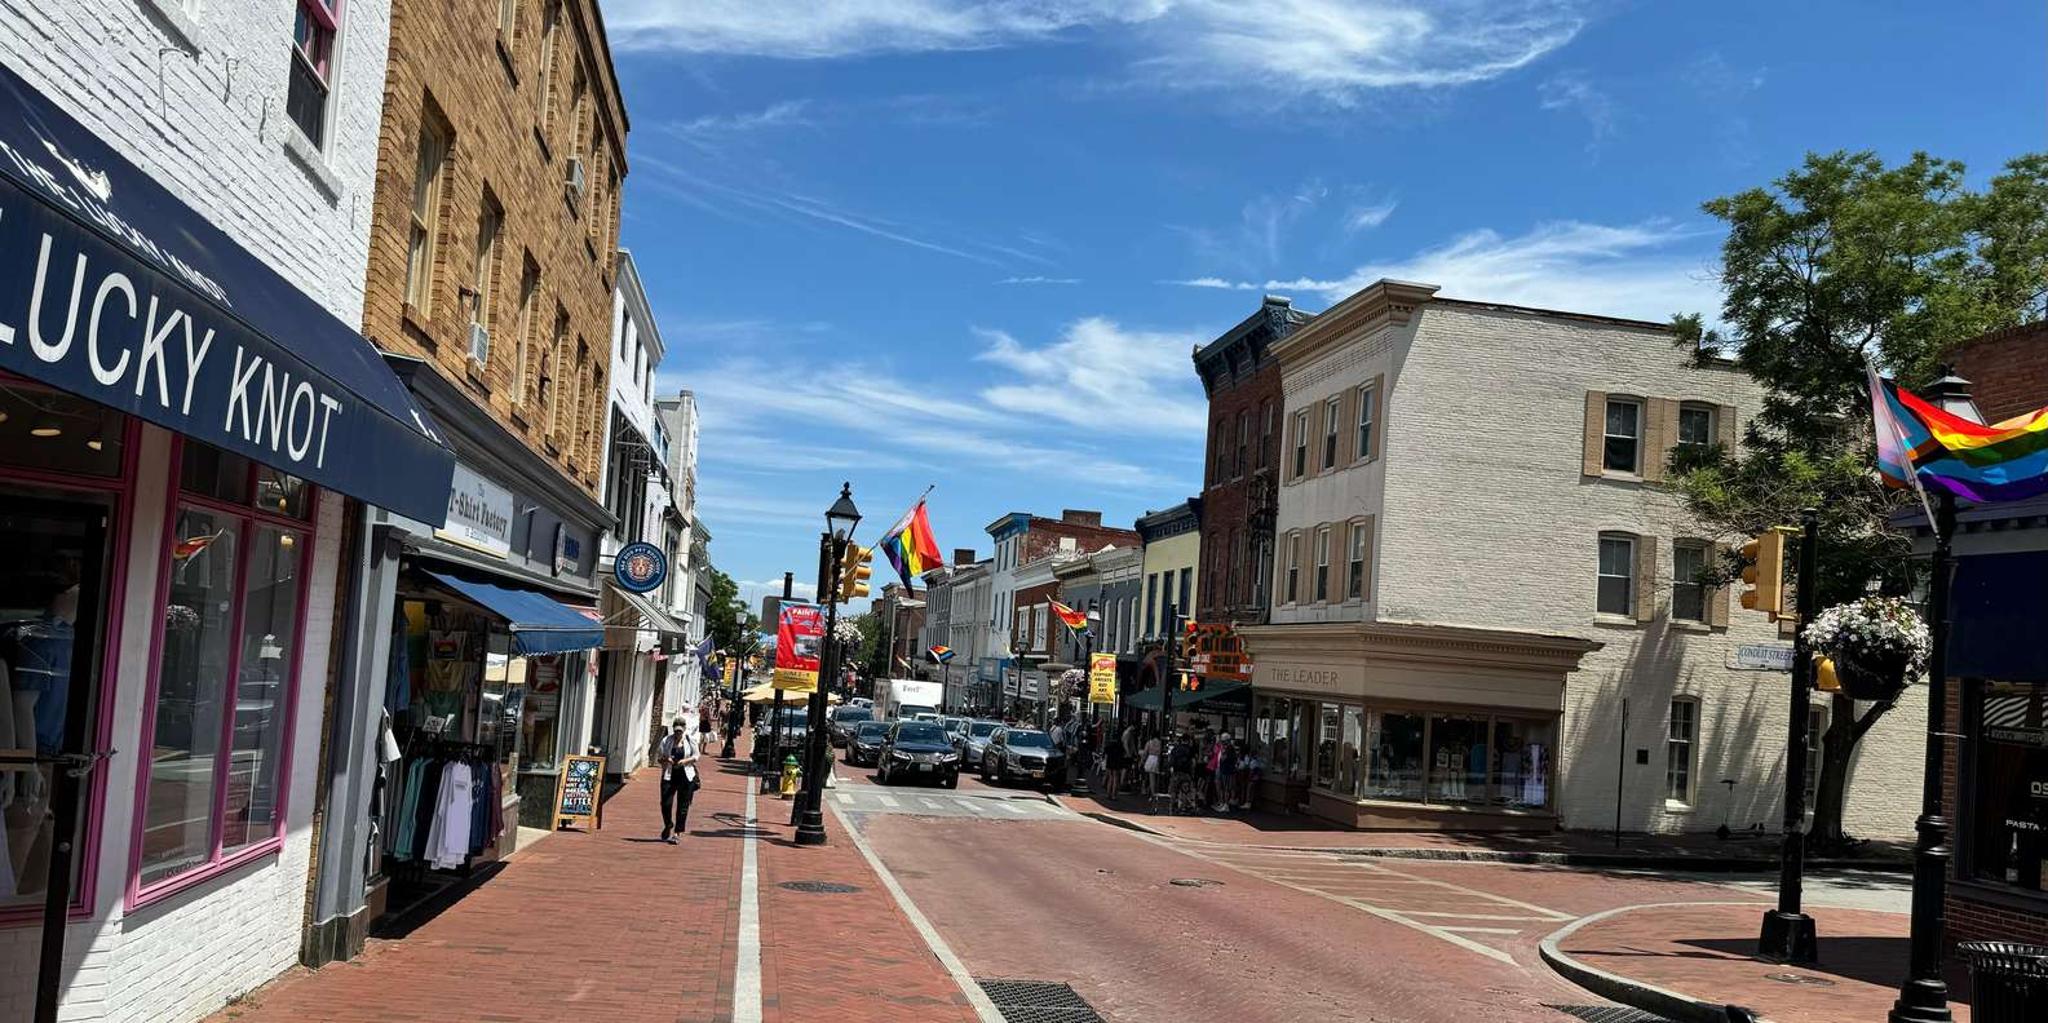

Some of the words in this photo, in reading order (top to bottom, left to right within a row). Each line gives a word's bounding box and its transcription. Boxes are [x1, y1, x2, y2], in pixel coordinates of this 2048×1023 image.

[68, 185, 169, 267] LUCKY
[162, 248, 234, 308] KNOT
[225, 345, 341, 468] KNOT
[450, 488, 480, 523] T-Shirt
[481, 503, 508, 538] Factory
[792, 608, 815, 616] PAINT
[1739, 647, 1767, 659] CONDUIT
[1768, 650, 1792, 660] STREET
[1271, 668, 1290, 681] THE
[1293, 669, 1338, 687] LEADER
[2005, 818, 2040, 831] PASTA
